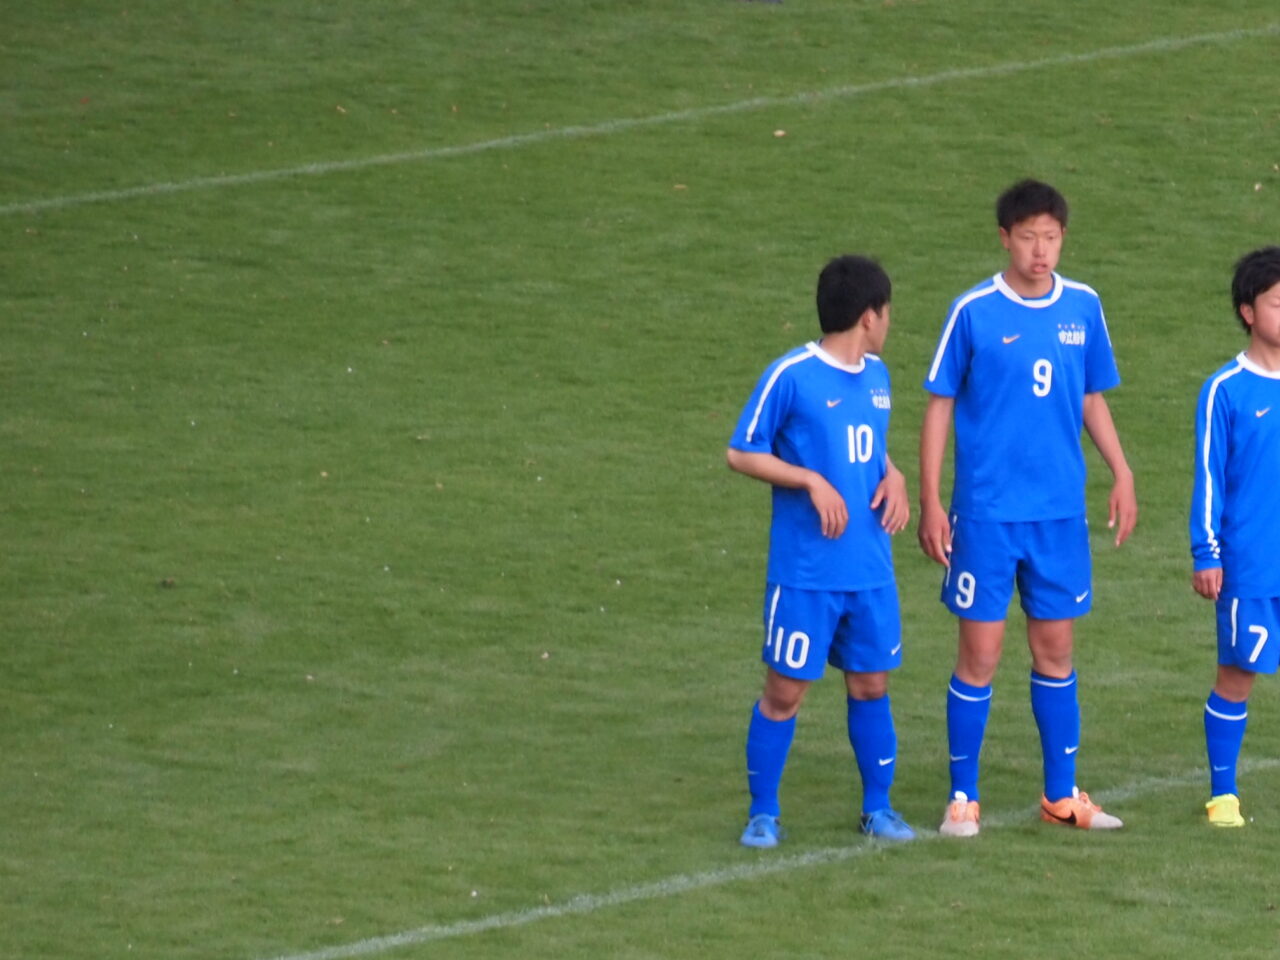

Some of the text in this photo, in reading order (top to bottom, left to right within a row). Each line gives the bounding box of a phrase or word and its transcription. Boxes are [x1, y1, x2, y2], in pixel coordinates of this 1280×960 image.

[1032, 358, 1053, 397] 9
[847, 424, 873, 463] 10
[955, 571, 976, 609] 9
[774, 626, 810, 669] 10
[1248, 624, 1268, 663] 7
